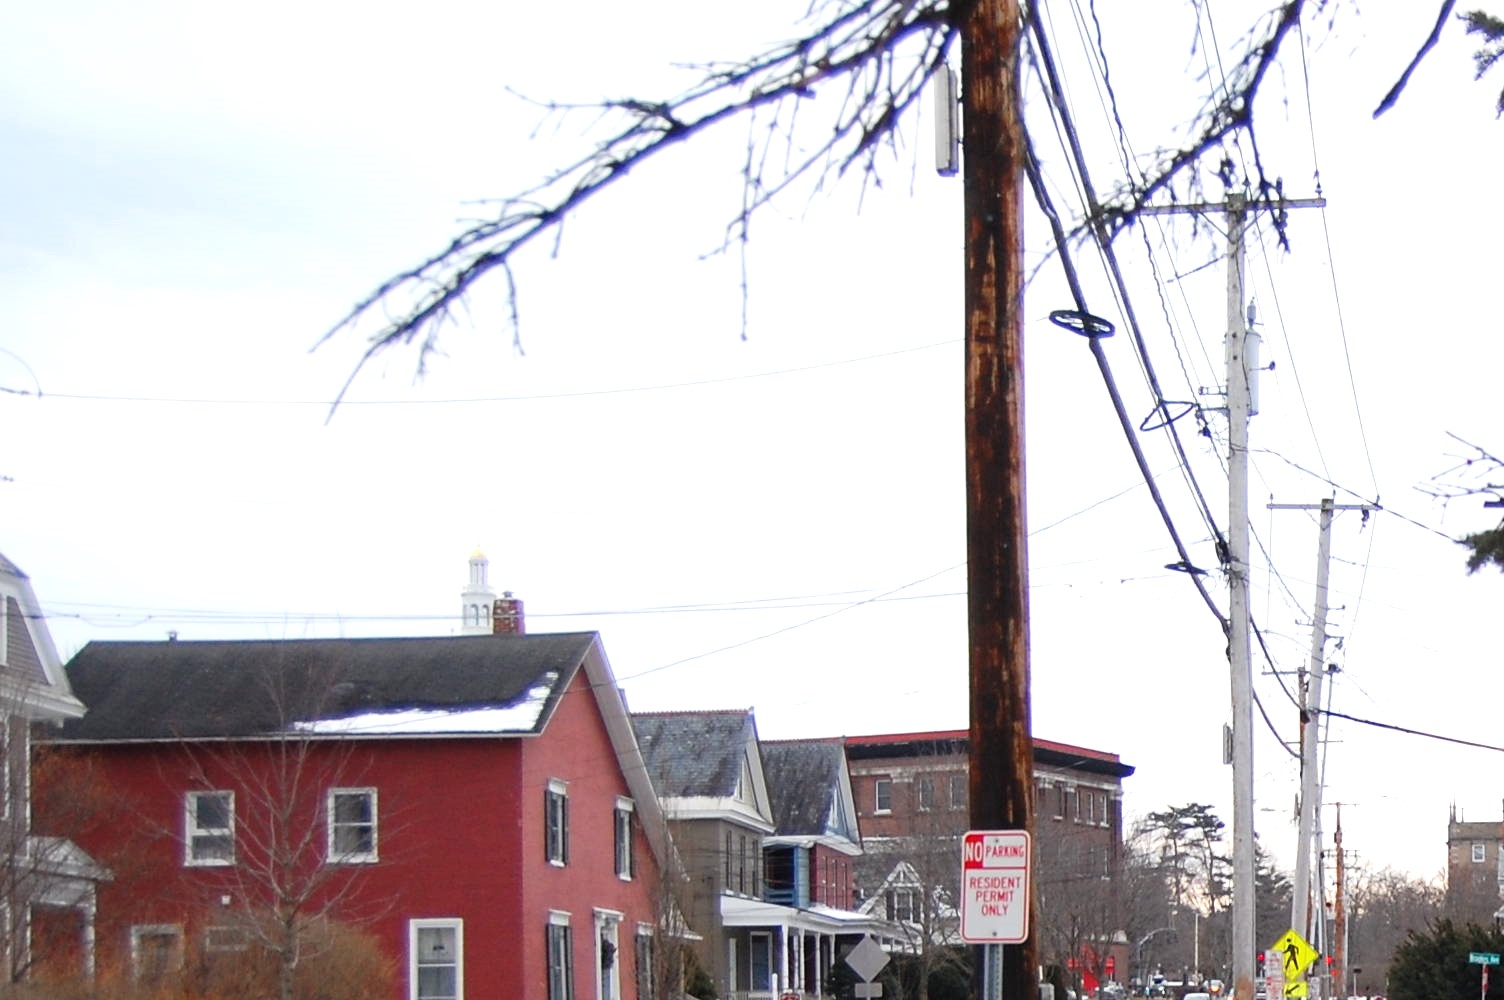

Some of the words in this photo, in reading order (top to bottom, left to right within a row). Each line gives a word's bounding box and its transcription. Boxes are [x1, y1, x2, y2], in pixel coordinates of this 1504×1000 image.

[965, 841, 983, 862] NO
[985, 846, 1024, 857] PARKING
[970, 877, 1021, 888] RESIDENT
[976, 891, 1014, 902] PERMIT
[981, 905, 1009, 916] ONLY
